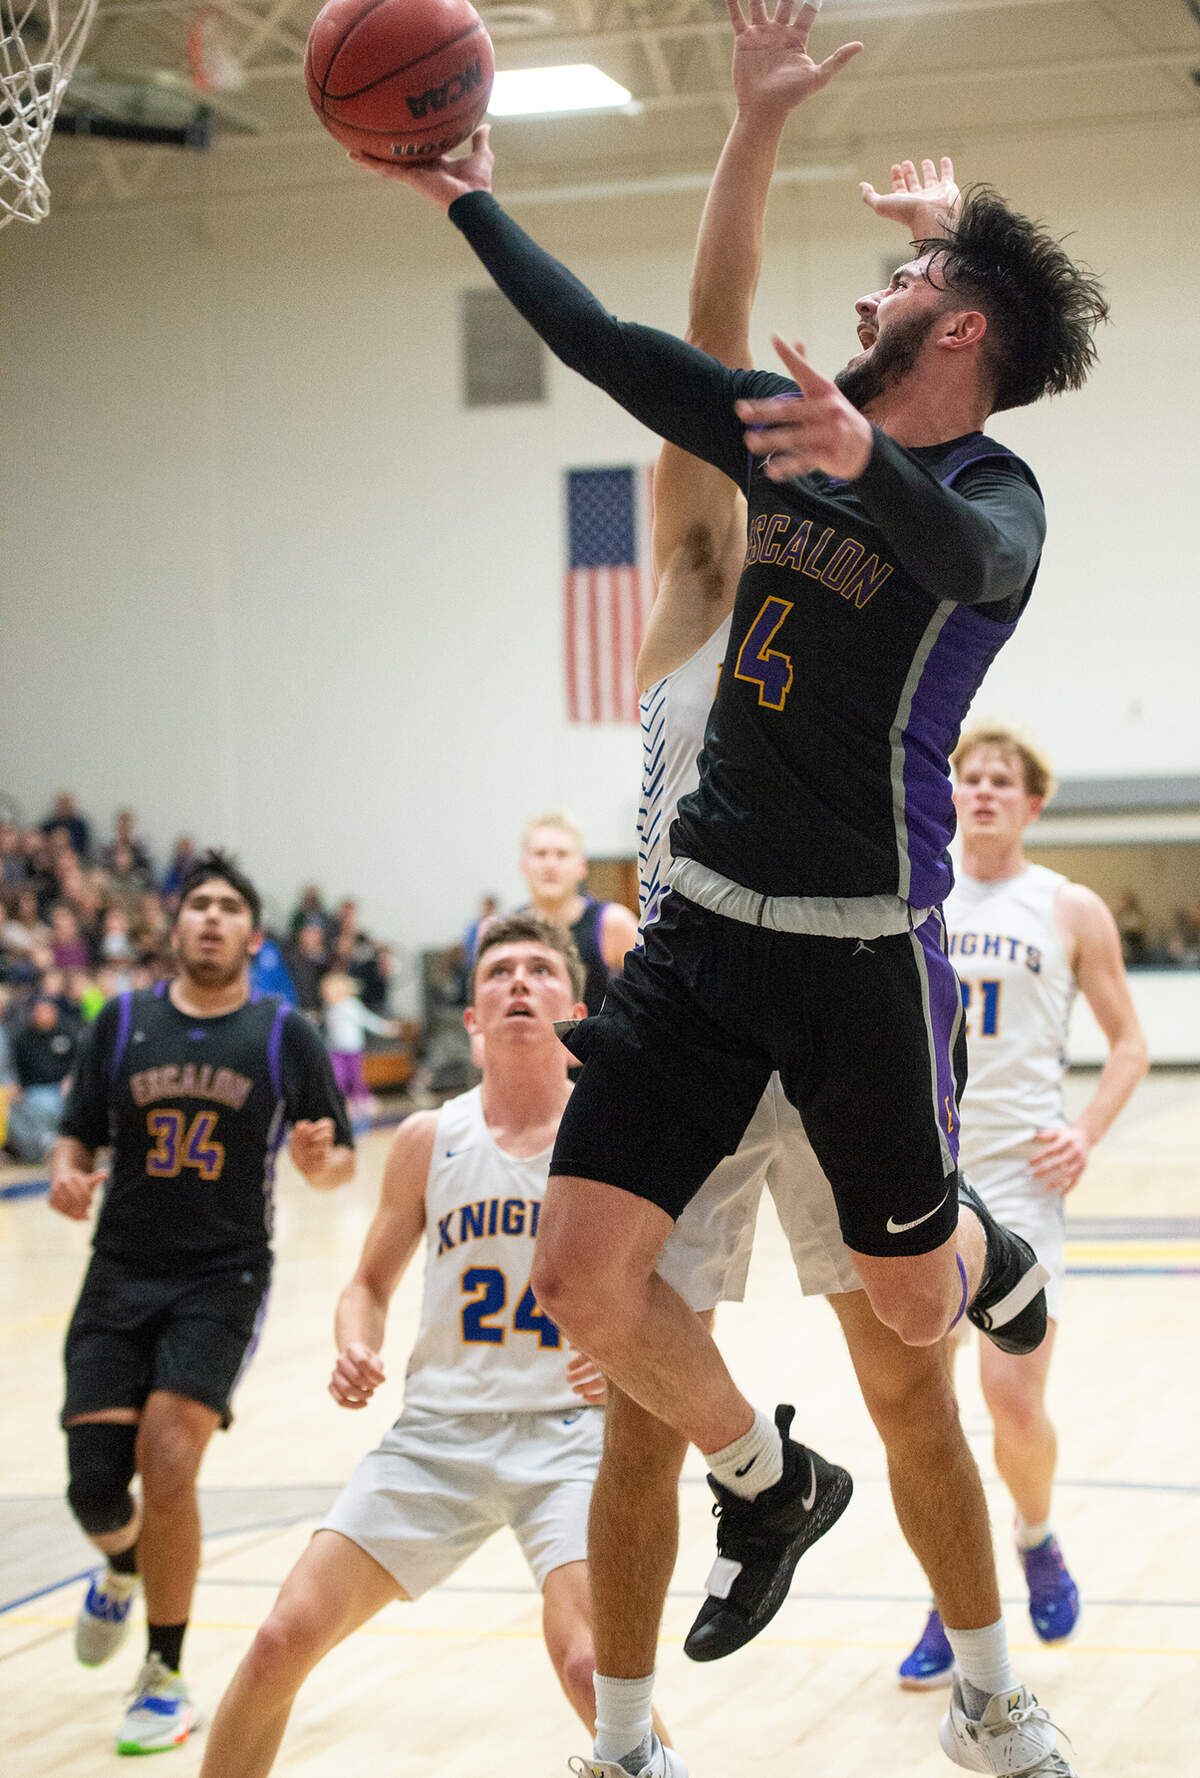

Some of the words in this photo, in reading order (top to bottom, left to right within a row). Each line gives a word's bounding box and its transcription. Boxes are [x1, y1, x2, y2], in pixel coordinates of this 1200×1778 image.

[404, 57, 482, 120] NCAA
[744, 513, 895, 609] SCALON
[733, 594, 795, 712] 4
[145, 1108, 226, 1181] 34
[459, 1264, 563, 1352] 24
